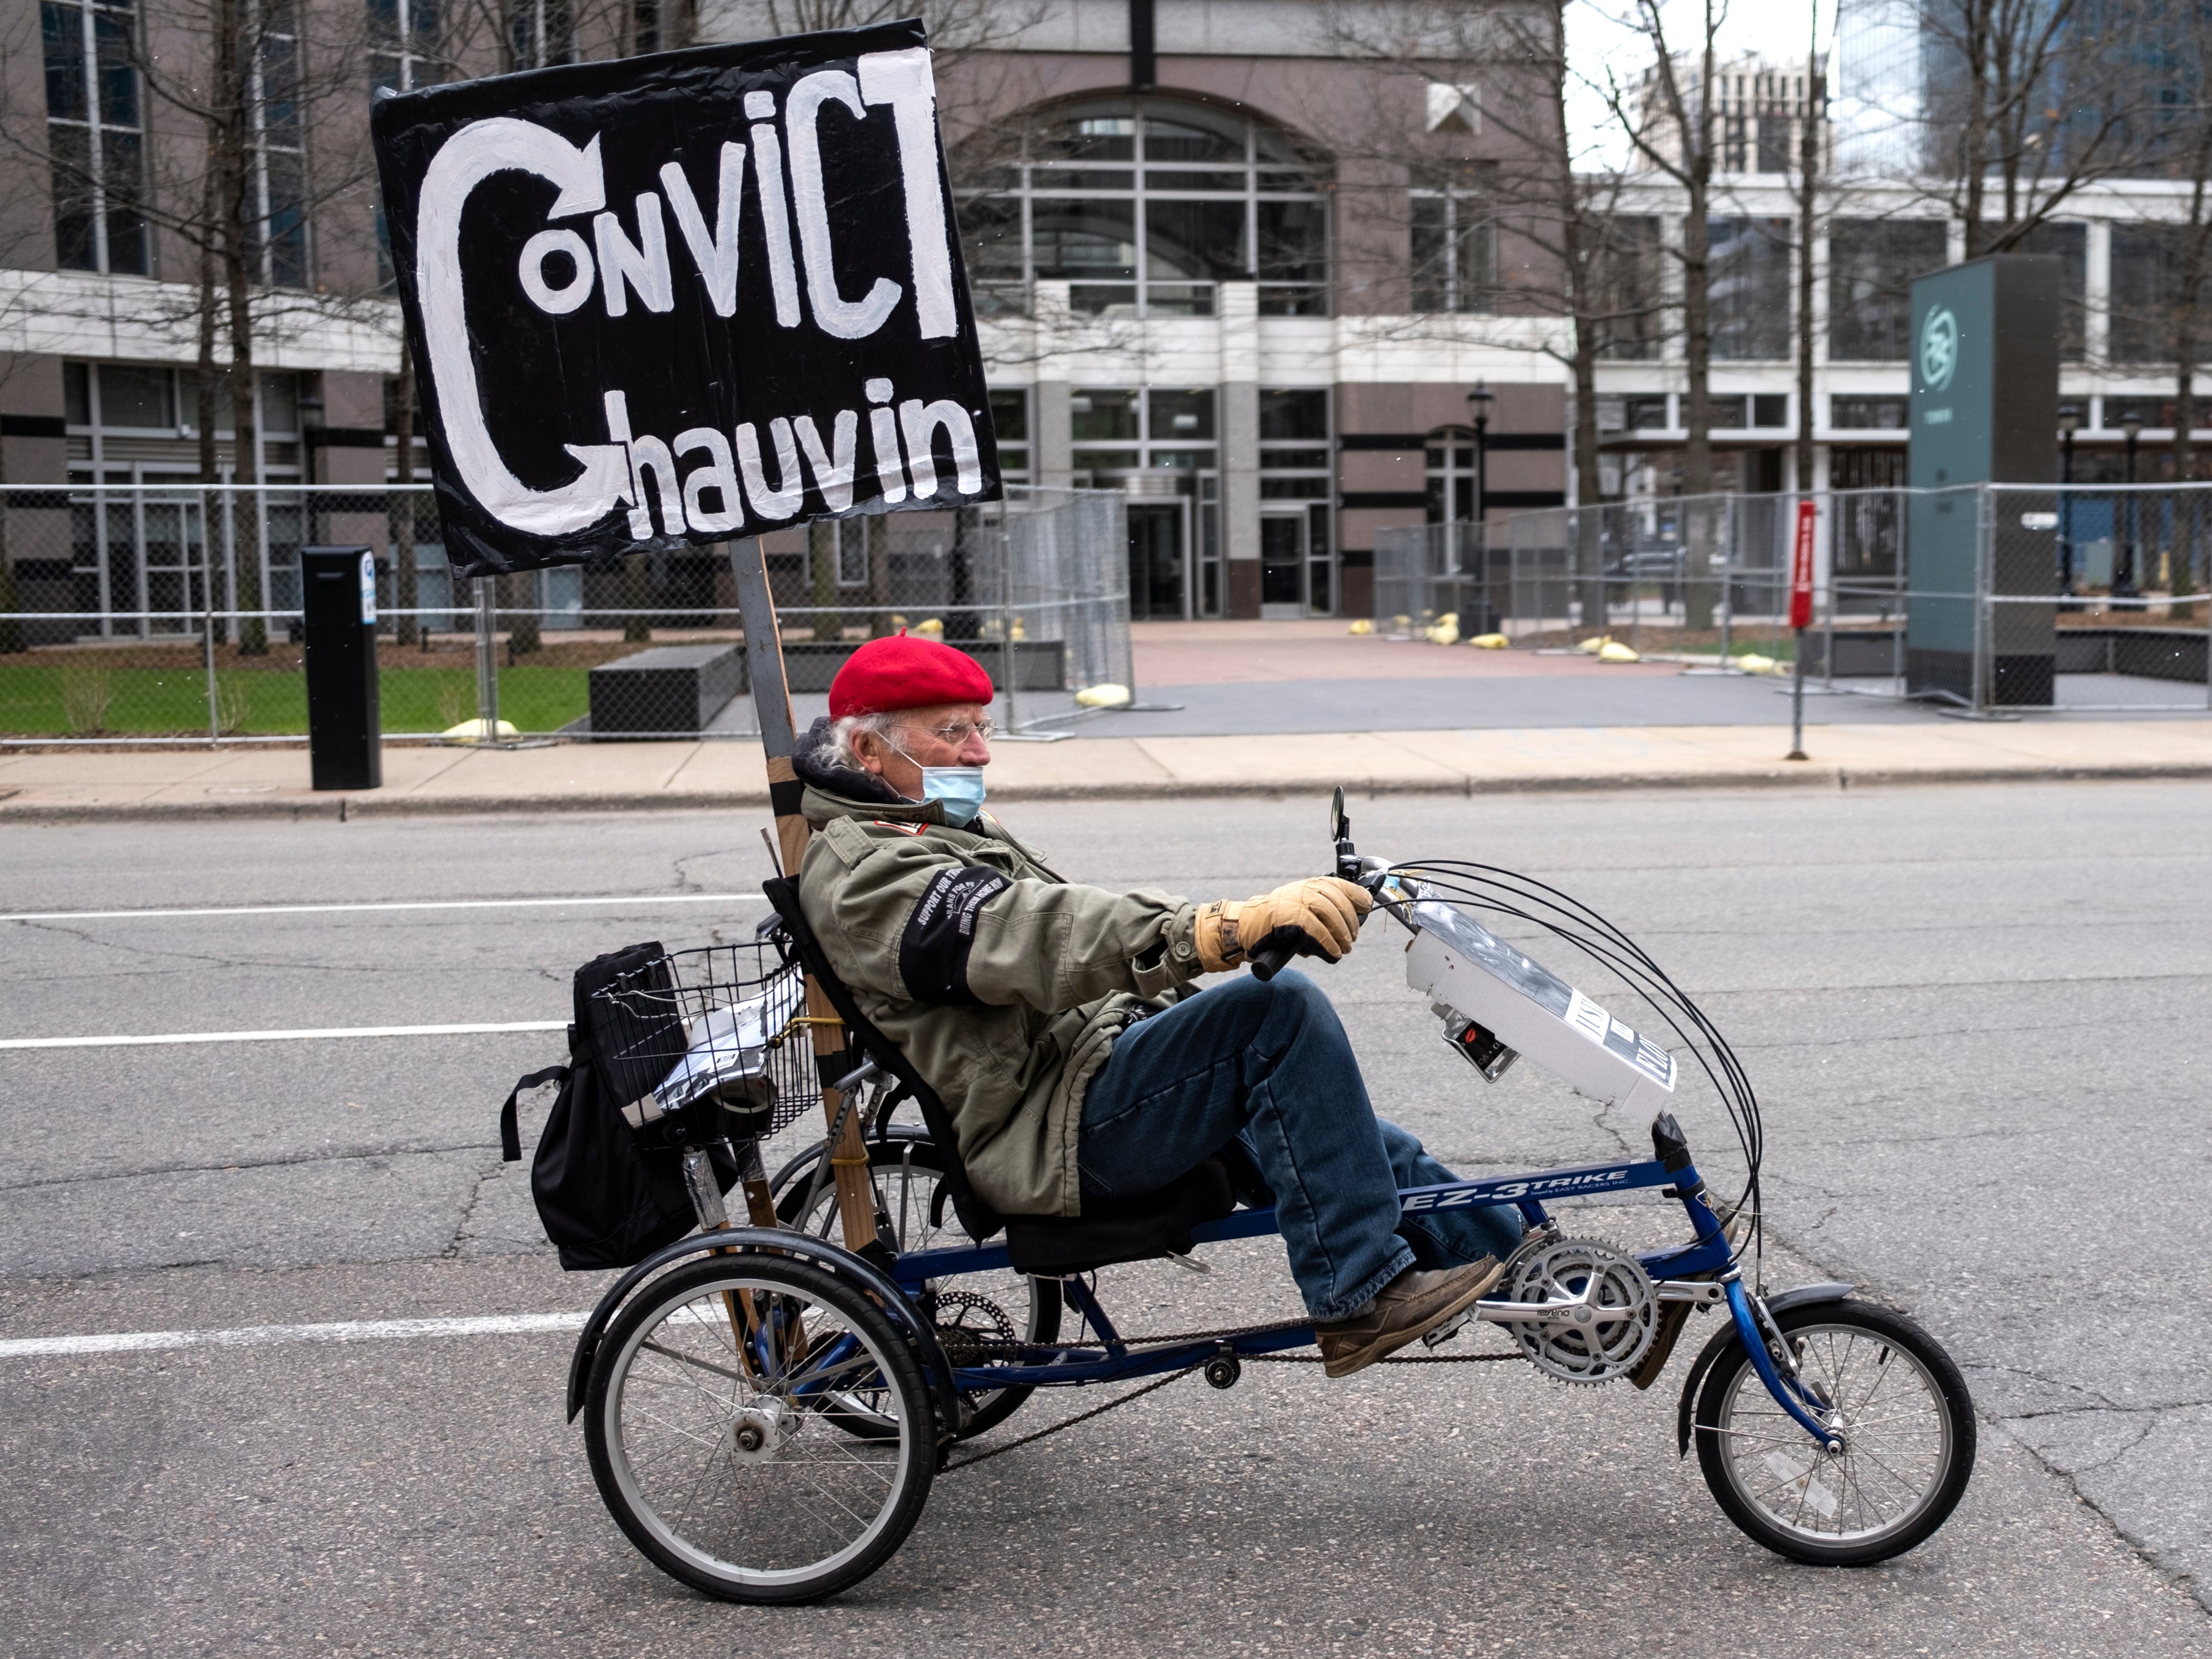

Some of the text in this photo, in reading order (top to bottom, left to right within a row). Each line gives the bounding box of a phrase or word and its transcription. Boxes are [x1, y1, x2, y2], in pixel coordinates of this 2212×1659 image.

[918, 890, 942, 925] SUPPORT
[936, 877, 952, 893] OUR
[951, 883, 967, 894] FOR
[959, 877, 1003, 935] BRING THEM HOME NOW
[1402, 1170, 1628, 1212] EZ-3 TRIKE
